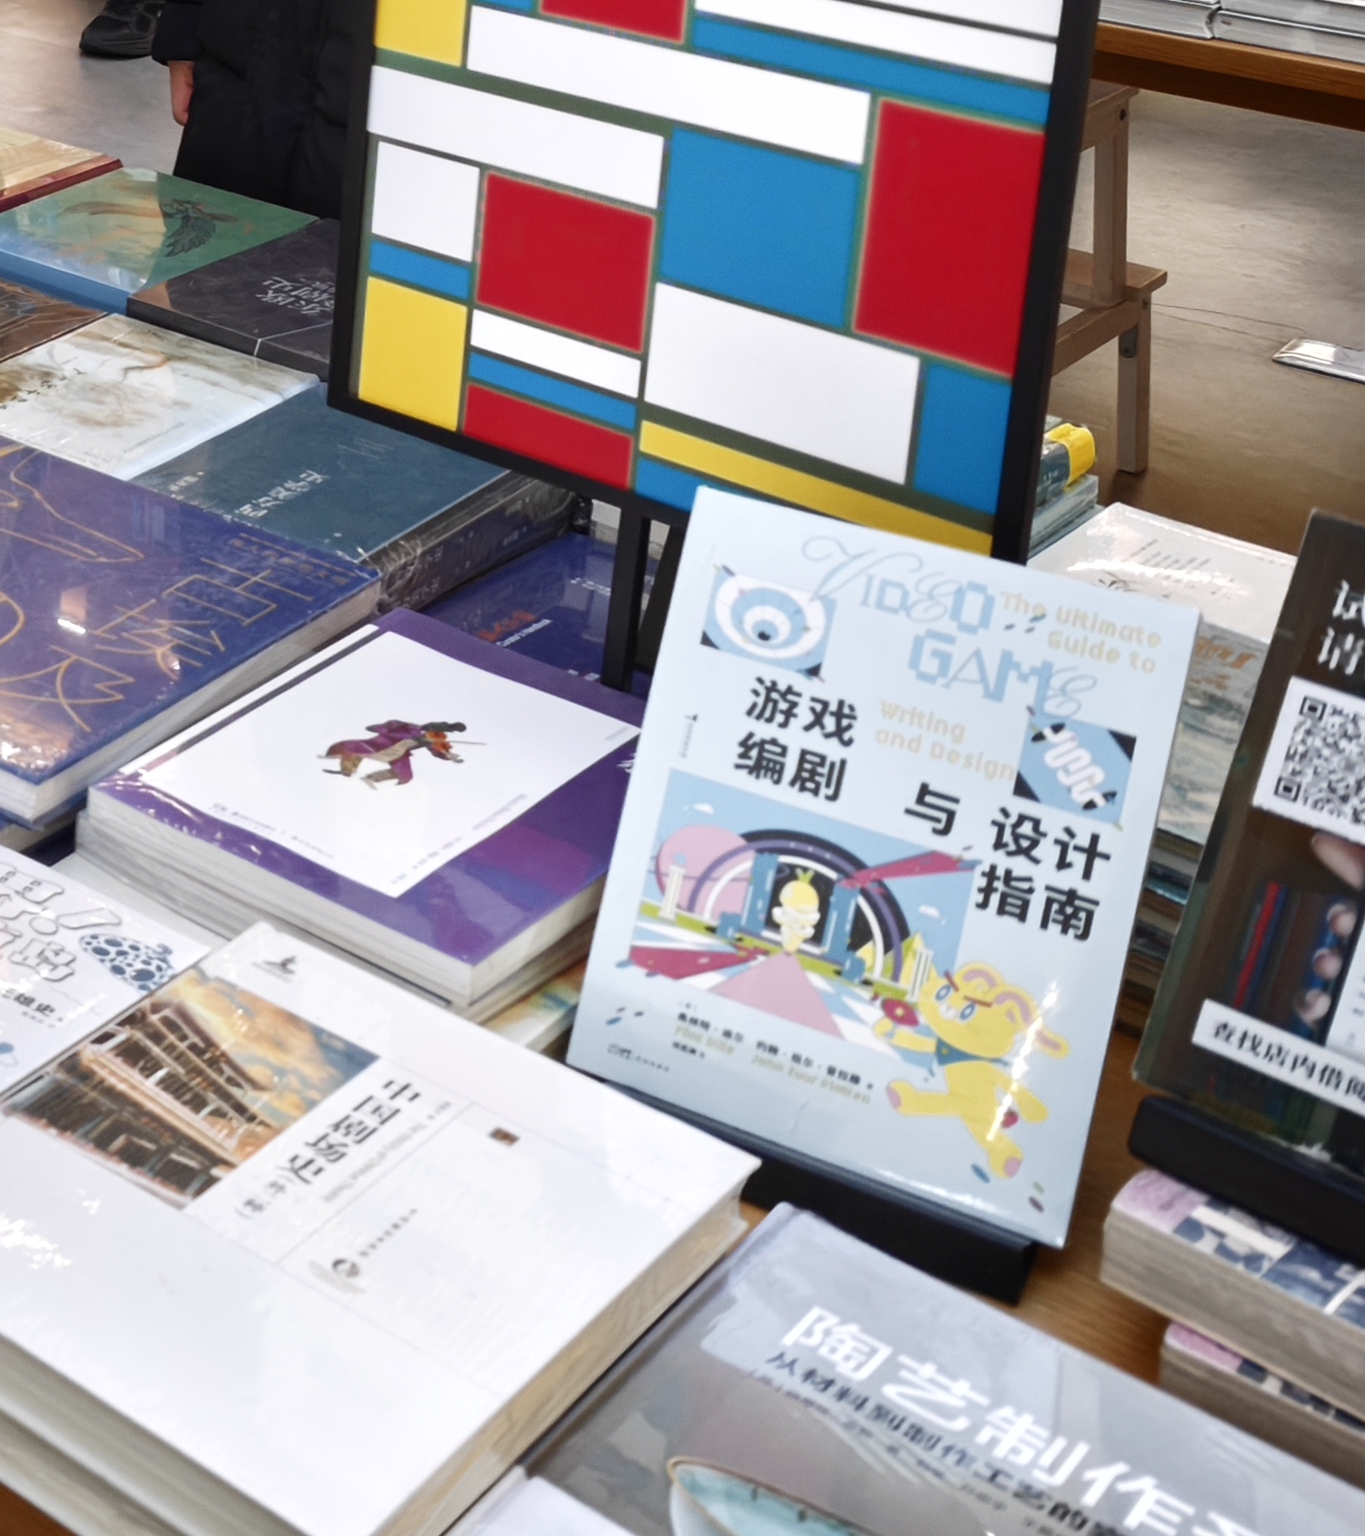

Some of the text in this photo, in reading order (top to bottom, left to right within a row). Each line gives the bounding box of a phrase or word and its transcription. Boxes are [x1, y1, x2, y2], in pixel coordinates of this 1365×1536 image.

[1000, 590, 1163, 650] The Ultimate
[1047, 632, 1158, 675] Guide to
[744, 676, 858, 749] 游戏
[878, 699, 967, 745] Writing
[732, 731, 849, 803] 编剧
[874, 728, 1017, 784] and Design
[905, 786, 963, 840] 与
[988, 806, 1112, 883] 设计
[975, 863, 1102, 942] 指南
[281, 1079, 421, 1186] 中国剧场史
[780, 1305, 1269, 1536] 陶艺制作
